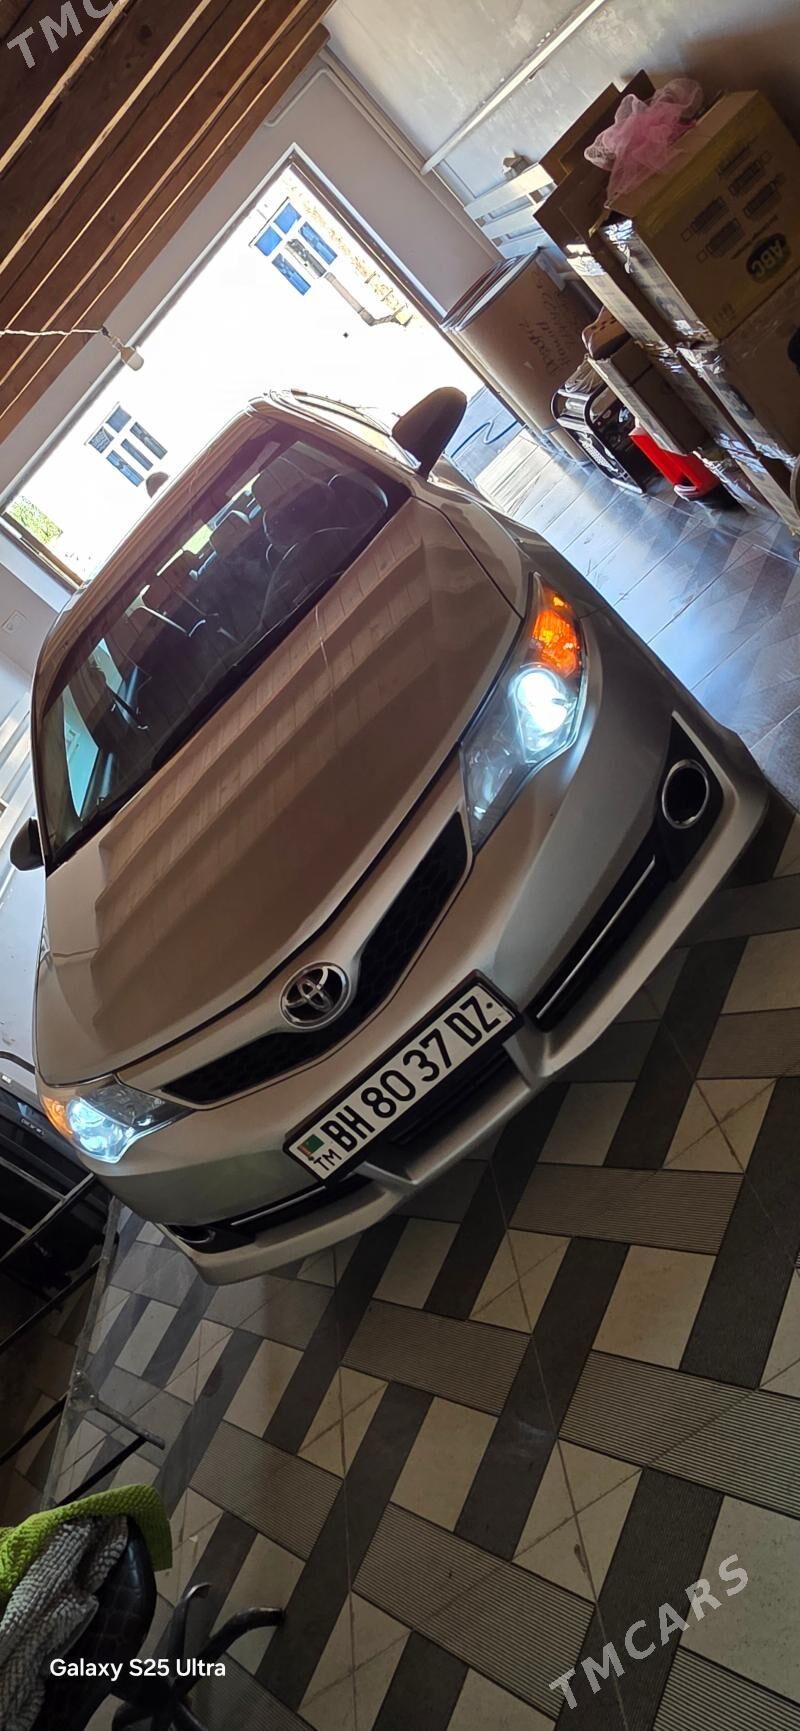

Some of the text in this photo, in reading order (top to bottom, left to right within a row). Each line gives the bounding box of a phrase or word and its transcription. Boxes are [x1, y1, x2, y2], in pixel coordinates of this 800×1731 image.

[751, 238, 785, 277] ABC
[320, 996, 501, 1152] BH 80 37 DZ
[313, 1148, 342, 1171] TM
